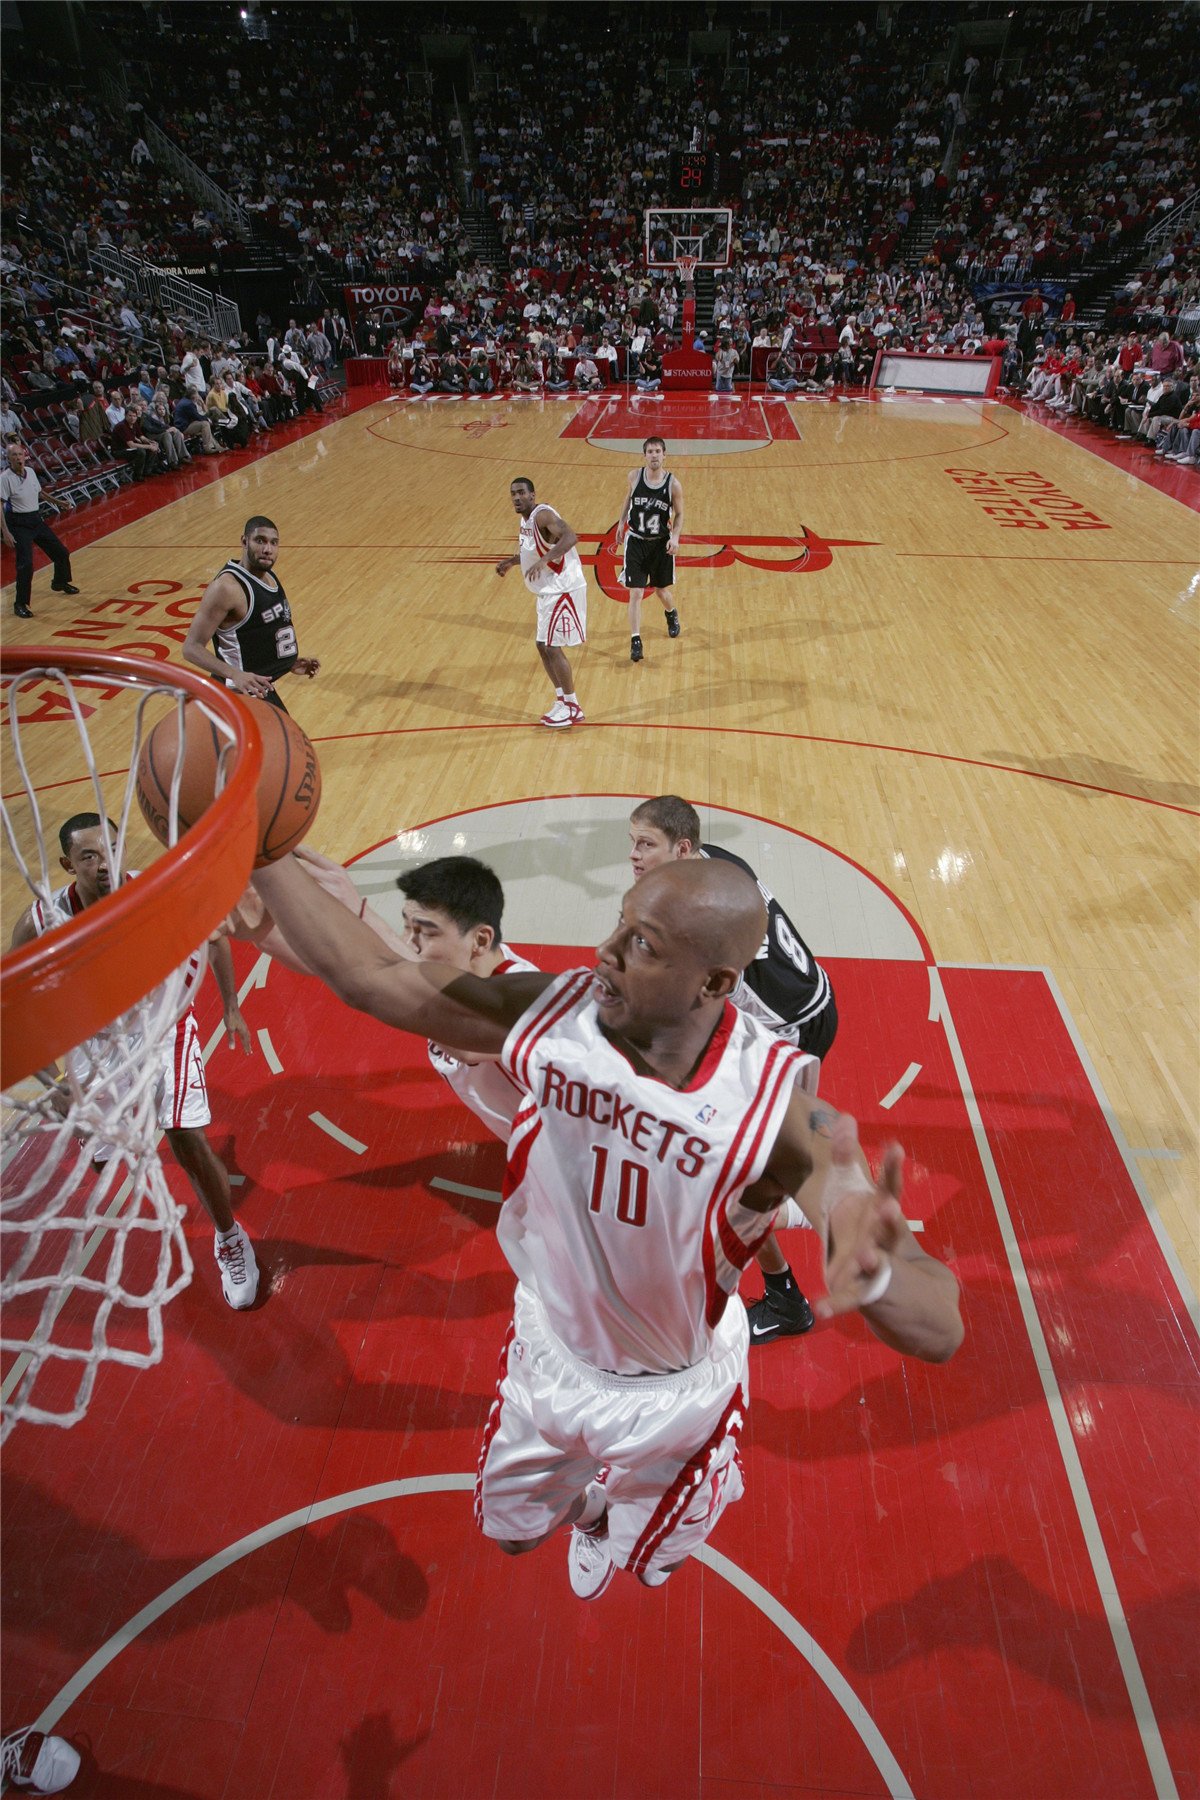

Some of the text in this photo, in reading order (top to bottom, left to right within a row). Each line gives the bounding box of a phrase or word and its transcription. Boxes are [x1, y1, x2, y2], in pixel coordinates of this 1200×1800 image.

[680, 167, 702, 188] 24
[183, 266, 206, 275] Tunnel
[350, 287, 423, 304] TOYOTA
[672, 369, 712, 377] STANFORD
[383, 394, 665, 402] HOUSTON
[634, 497, 669, 511] SPURS
[944, 468, 1050, 530] CENTER
[995, 470, 1113, 531] TOYOTA
[637, 512, 660, 535] 14
[775, 913, 810, 976] 8
[540, 1061, 711, 1179] ROCKETS
[588, 1144, 650, 1228] 10
